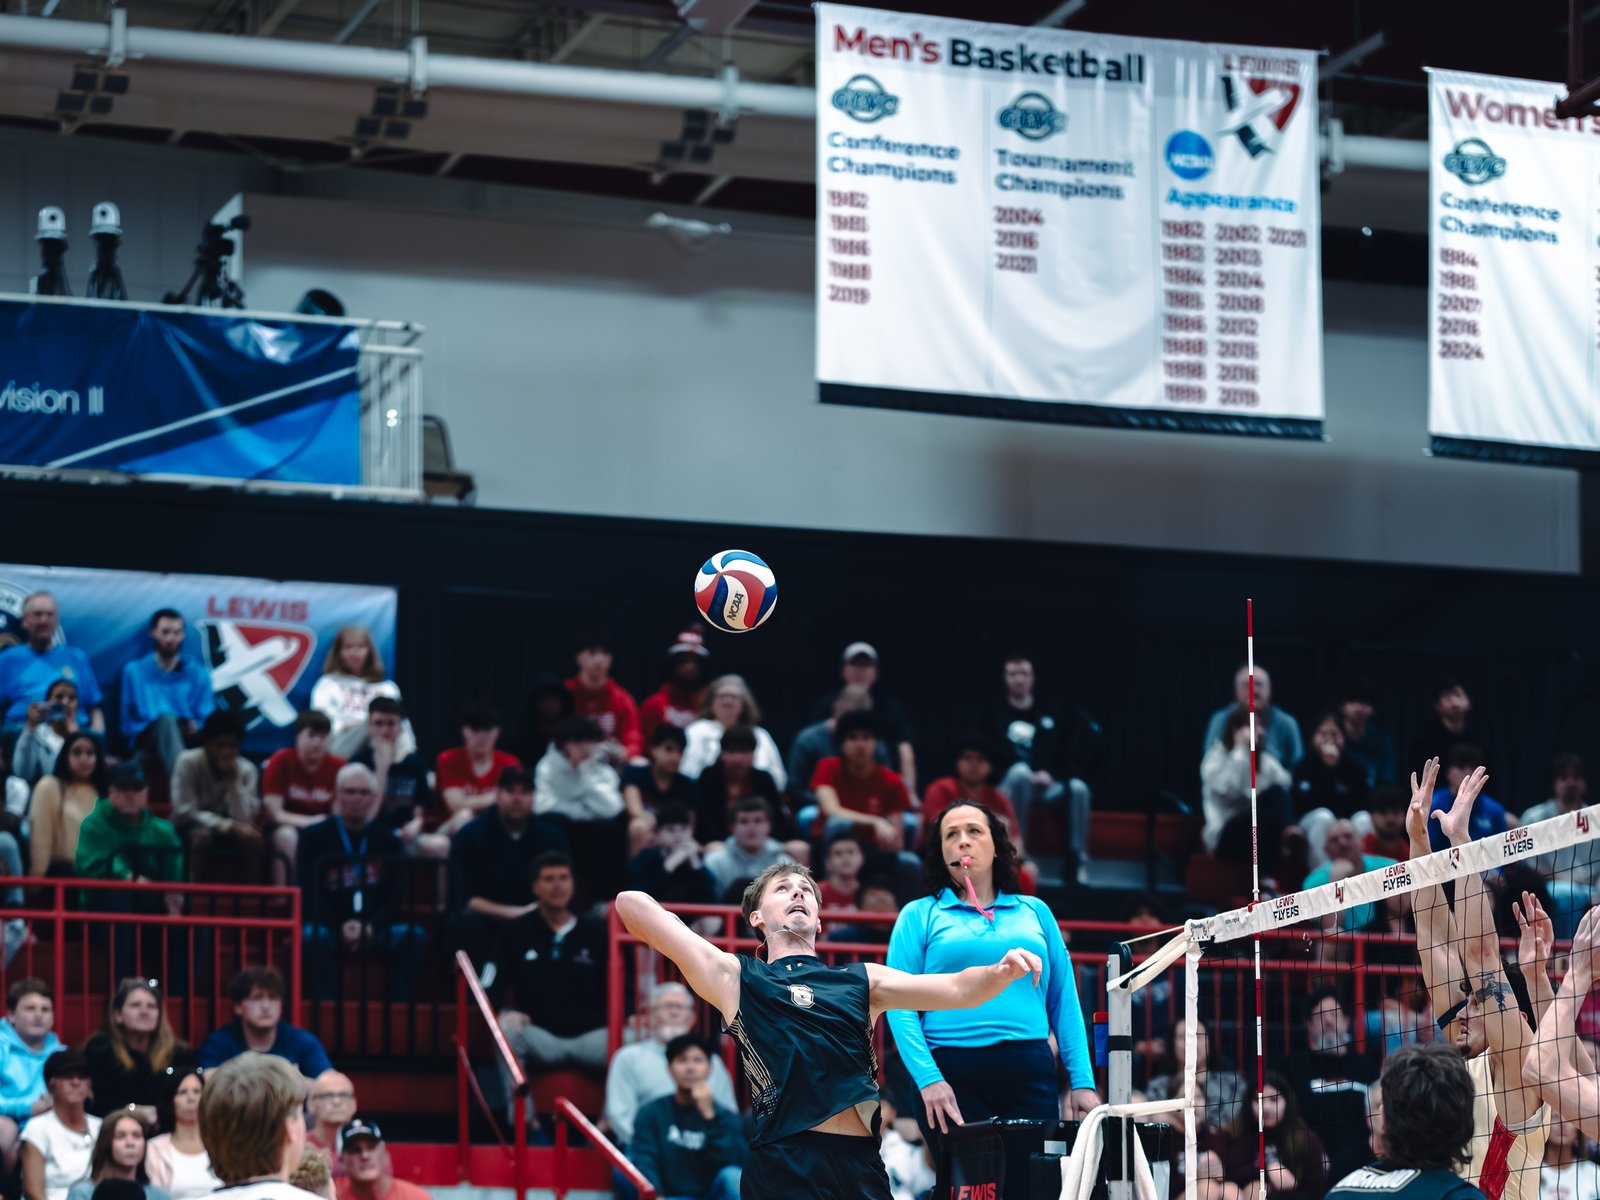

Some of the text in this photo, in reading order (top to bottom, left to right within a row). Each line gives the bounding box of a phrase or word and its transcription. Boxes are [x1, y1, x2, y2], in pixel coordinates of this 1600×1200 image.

[833, 24, 1145, 83] Men's Basketball
[828, 132, 960, 160] Conference
[827, 156, 957, 184] Champions
[995, 148, 1135, 177] Tournament
[995, 173, 1124, 202] Champions
[1440, 191, 1561, 221] Conference
[1440, 215, 1559, 244] Champions
[1215, 269, 1265, 290] 2004
[208, 595, 309, 621] LEWIS
[727, 591, 744, 620] NCAA
[1503, 838, 1533, 857] FLYERS
[1505, 827, 1529, 843] LEWIS
[1383, 873, 1411, 892] FLYERS
[1385, 863, 1406, 878] LEWIS
[1273, 905, 1299, 921] FLYERS
[1275, 895, 1295, 909] LEWIS
